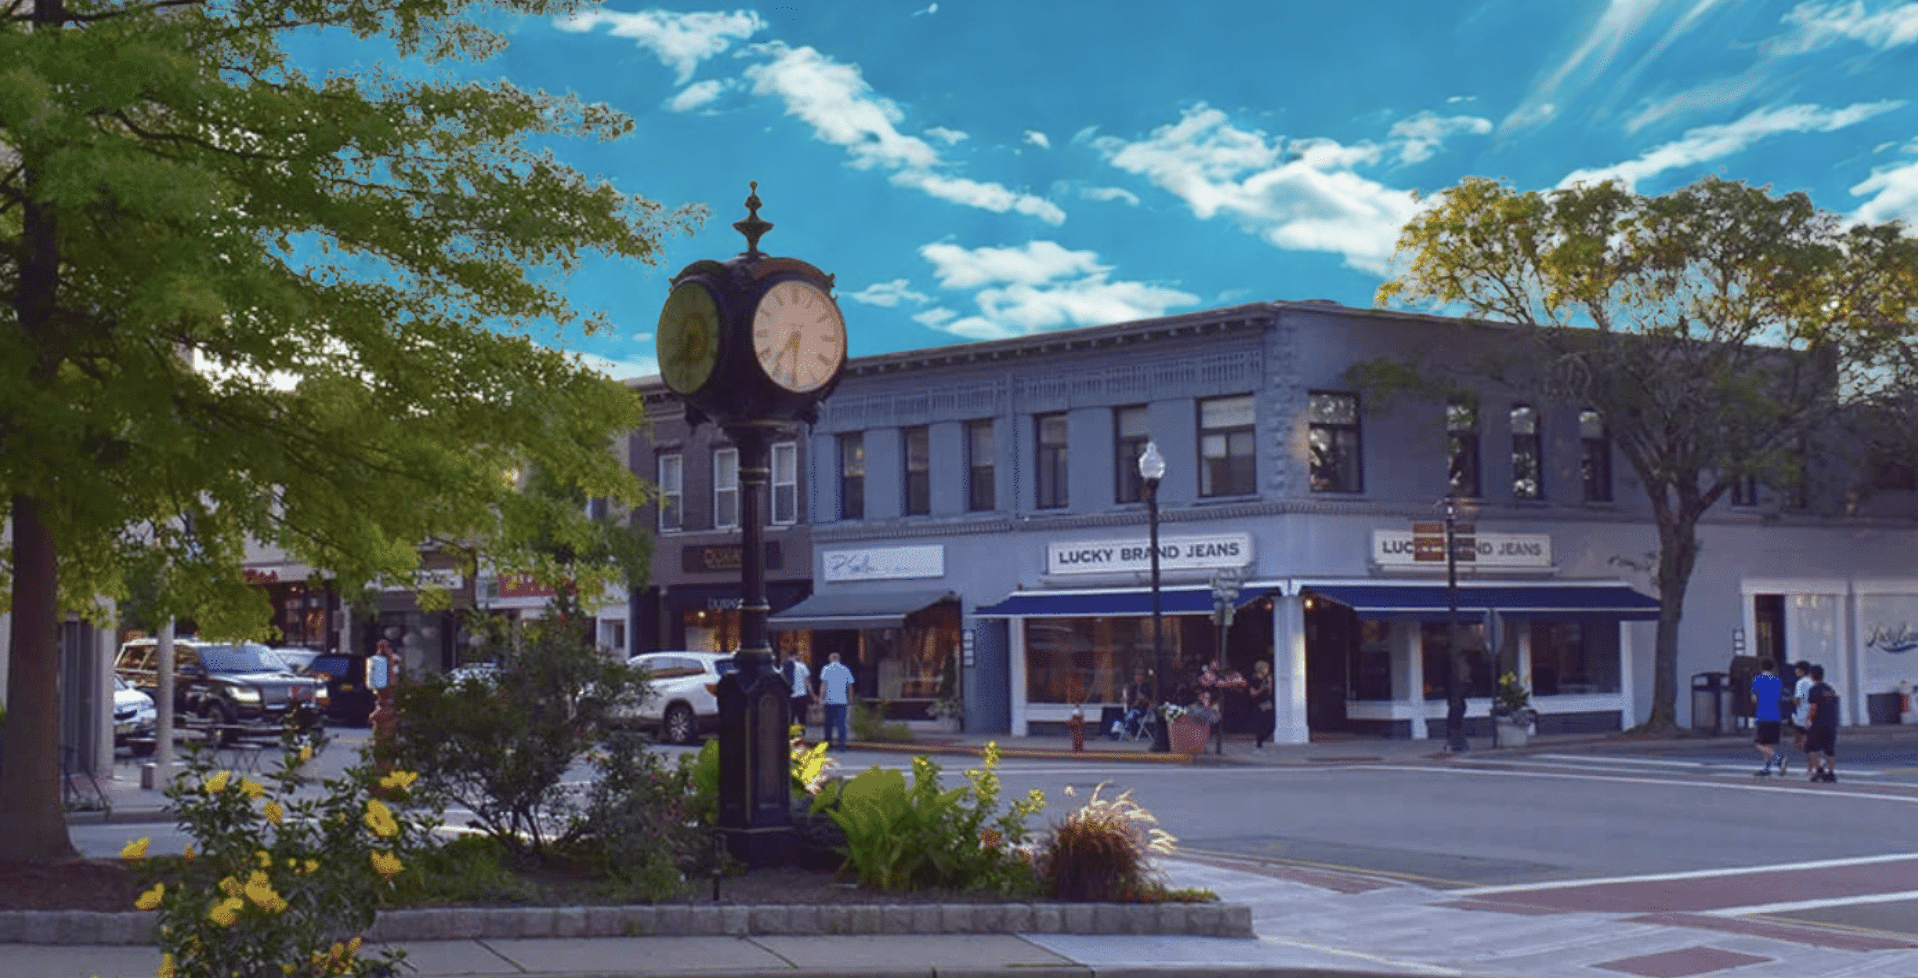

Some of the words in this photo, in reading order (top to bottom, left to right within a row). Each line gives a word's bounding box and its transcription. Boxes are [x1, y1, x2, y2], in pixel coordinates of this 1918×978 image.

[1059, 549, 1114, 564] LUCKY
[1121, 545, 1180, 561] BRAND
[1187, 542, 1240, 558] JEANS
[1382, 540, 1413, 554] LUC
[1498, 542, 1542, 555] JEANS
